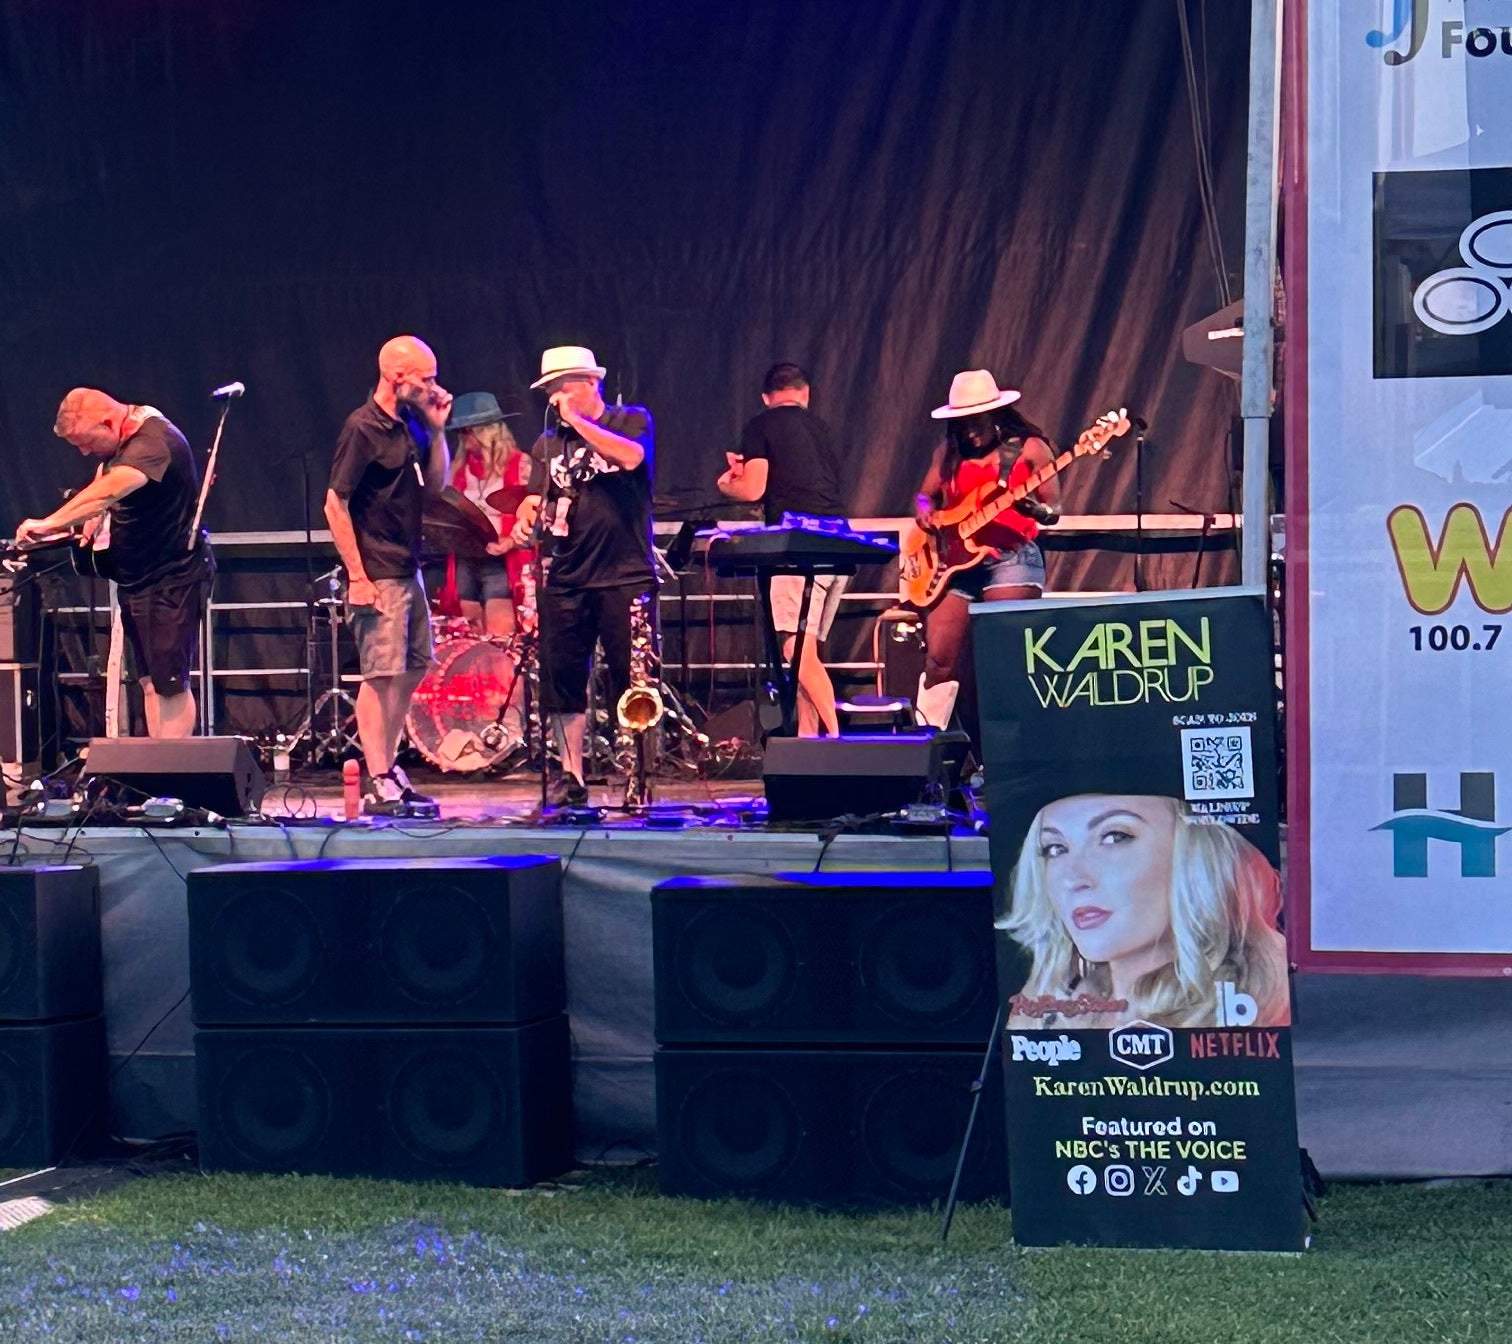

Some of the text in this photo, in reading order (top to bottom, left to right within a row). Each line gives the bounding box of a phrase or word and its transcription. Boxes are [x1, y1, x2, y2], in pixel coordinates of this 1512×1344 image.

[1024, 616, 1211, 674] KAREN
[1409, 624, 1503, 651] 100.7
[1027, 666, 1214, 708] WALDRUP
[1010, 1032, 1280, 1066] People CMT NETFLIX
[1033, 1076, 1260, 1101] KarenWaldrup.com
[1081, 1116, 1216, 1136] Featured on
[1055, 1140, 1247, 1160] NBC's THE VOICE
